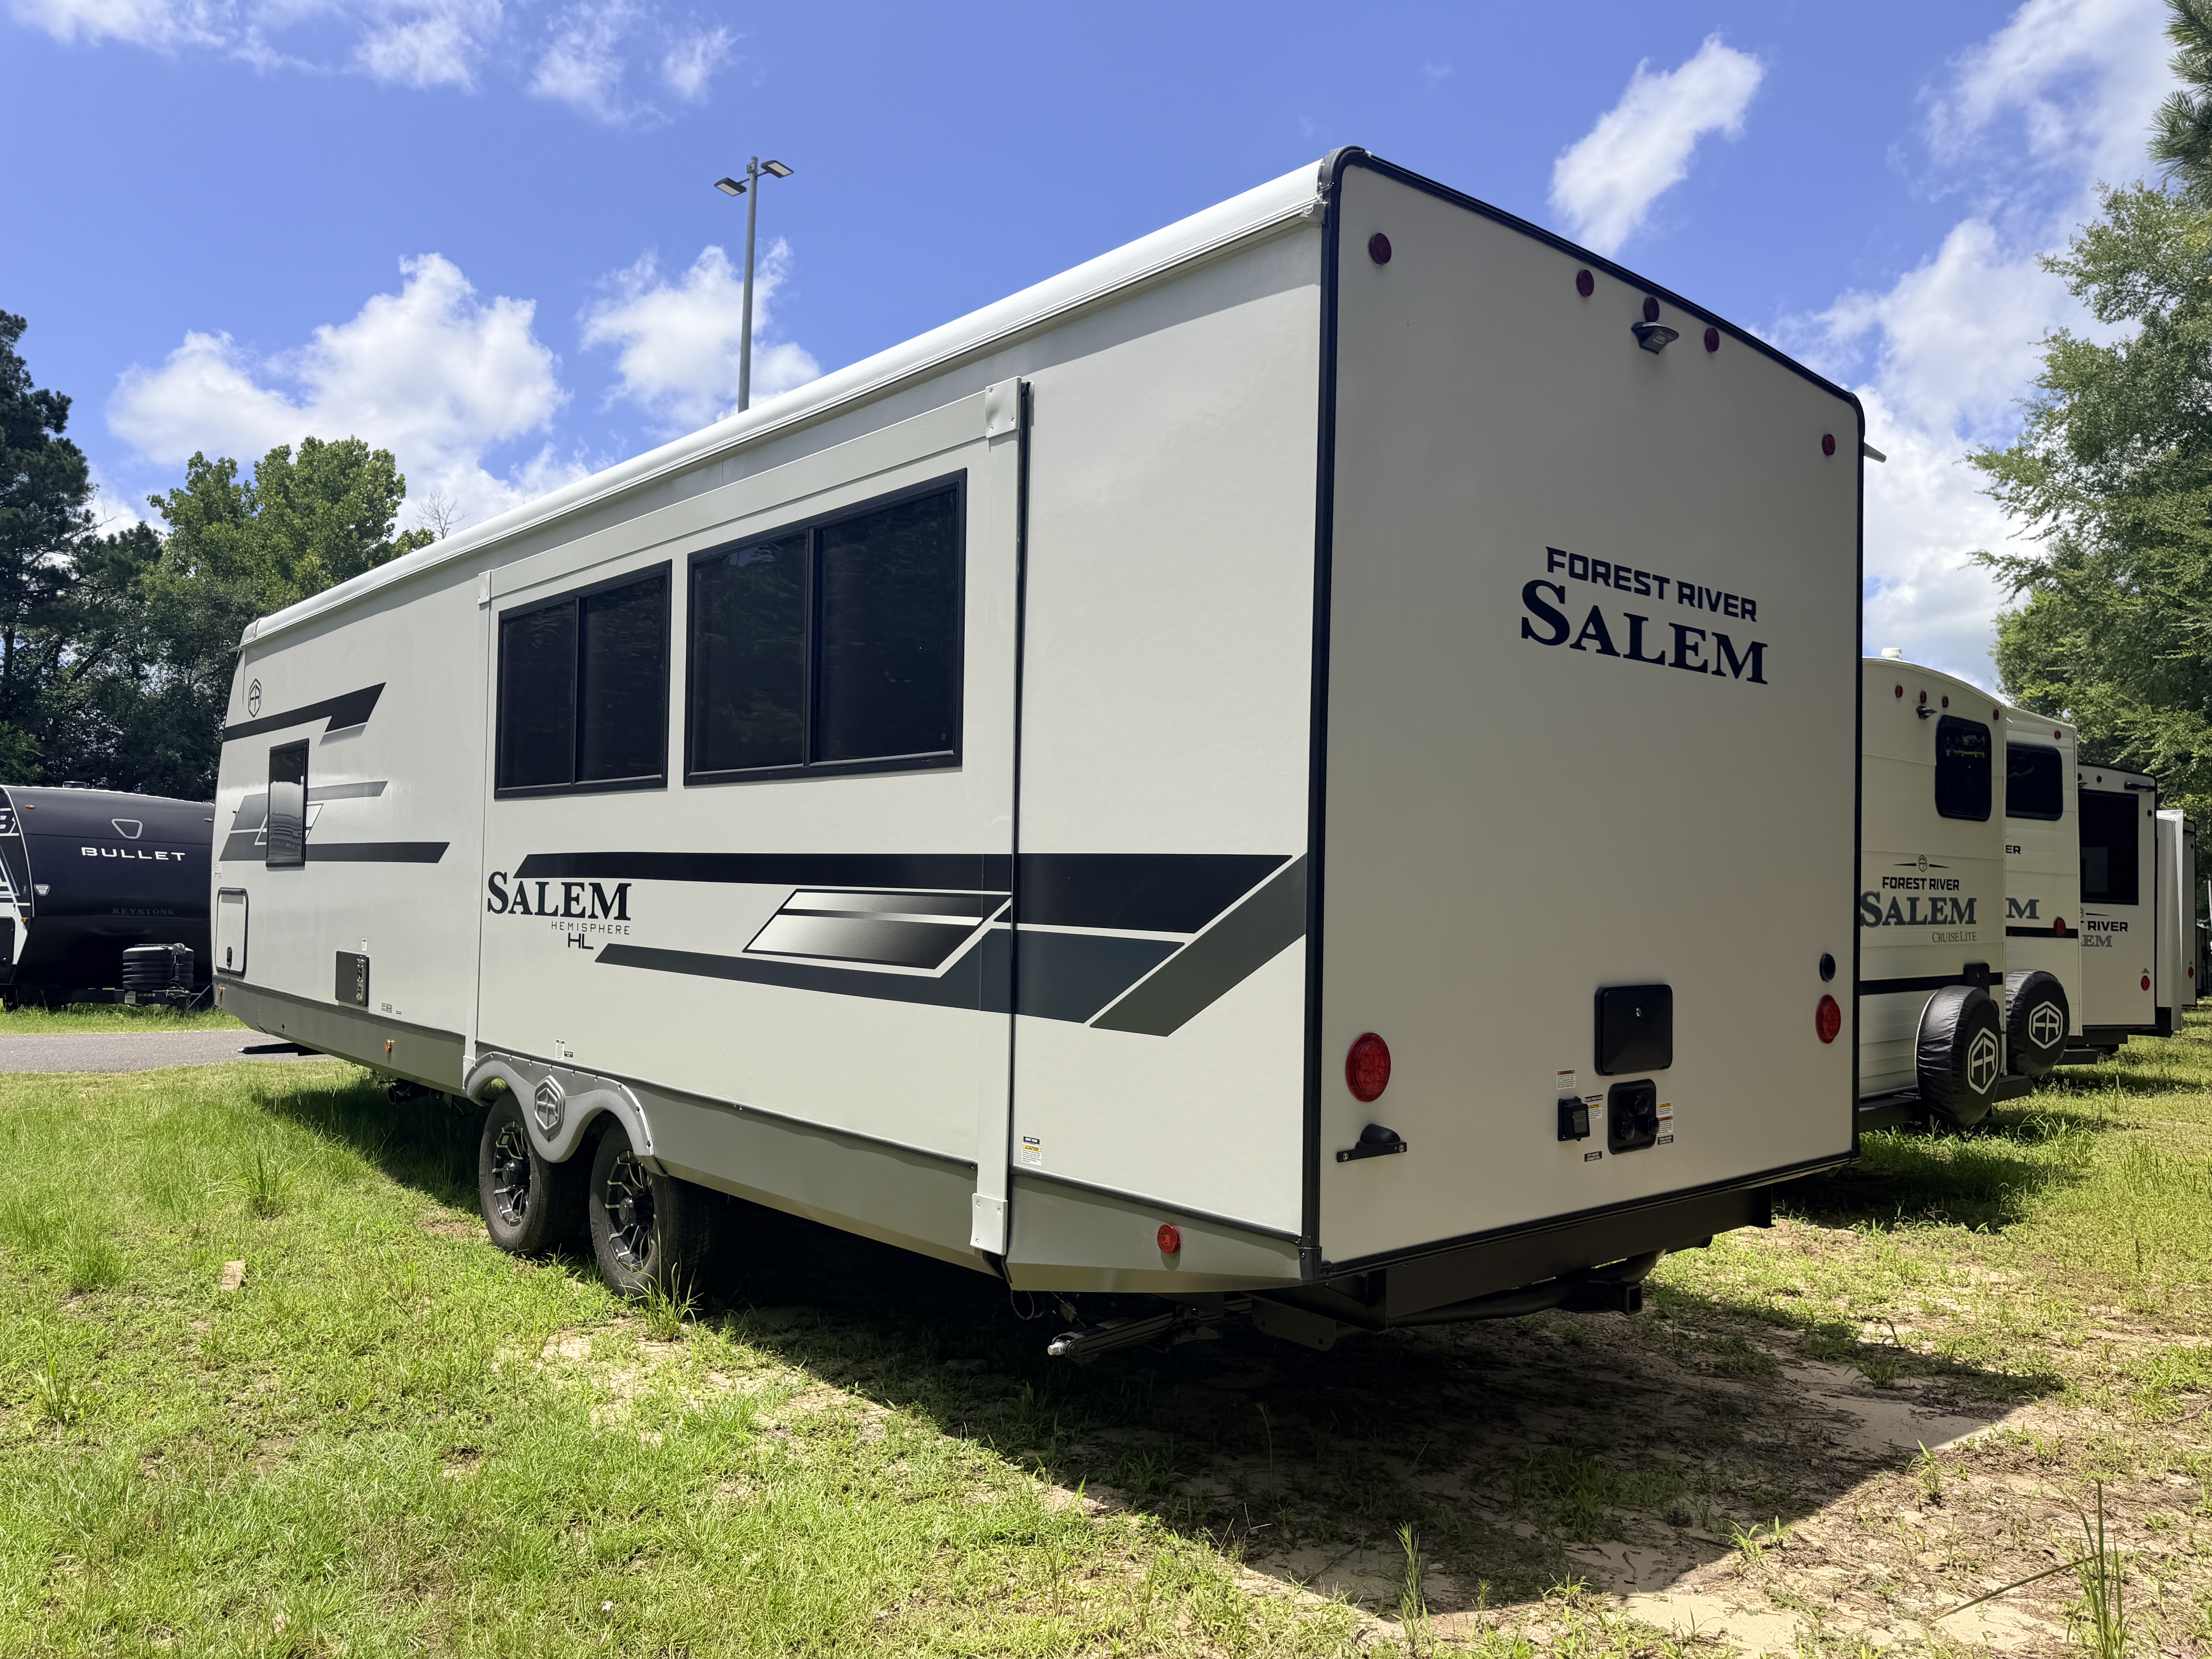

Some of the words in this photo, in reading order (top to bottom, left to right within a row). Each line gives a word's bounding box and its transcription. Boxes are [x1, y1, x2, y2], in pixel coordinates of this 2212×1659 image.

[1546, 546, 1670, 600] FOREST
[1676, 580, 1757, 622] RIVER
[1521, 579, 1768, 685] SALEM
[81, 847, 185, 861] BULLET
[1882, 876, 1927, 890] FOREST
[1929, 878, 1960, 891] RIVER
[487, 871, 632, 921] SALEM
[1860, 891, 1977, 927] SALEM
[551, 921, 630, 935] HEMISPHERE
[2087, 921, 2128, 932] RIVER
[568, 933, 594, 950] HL
